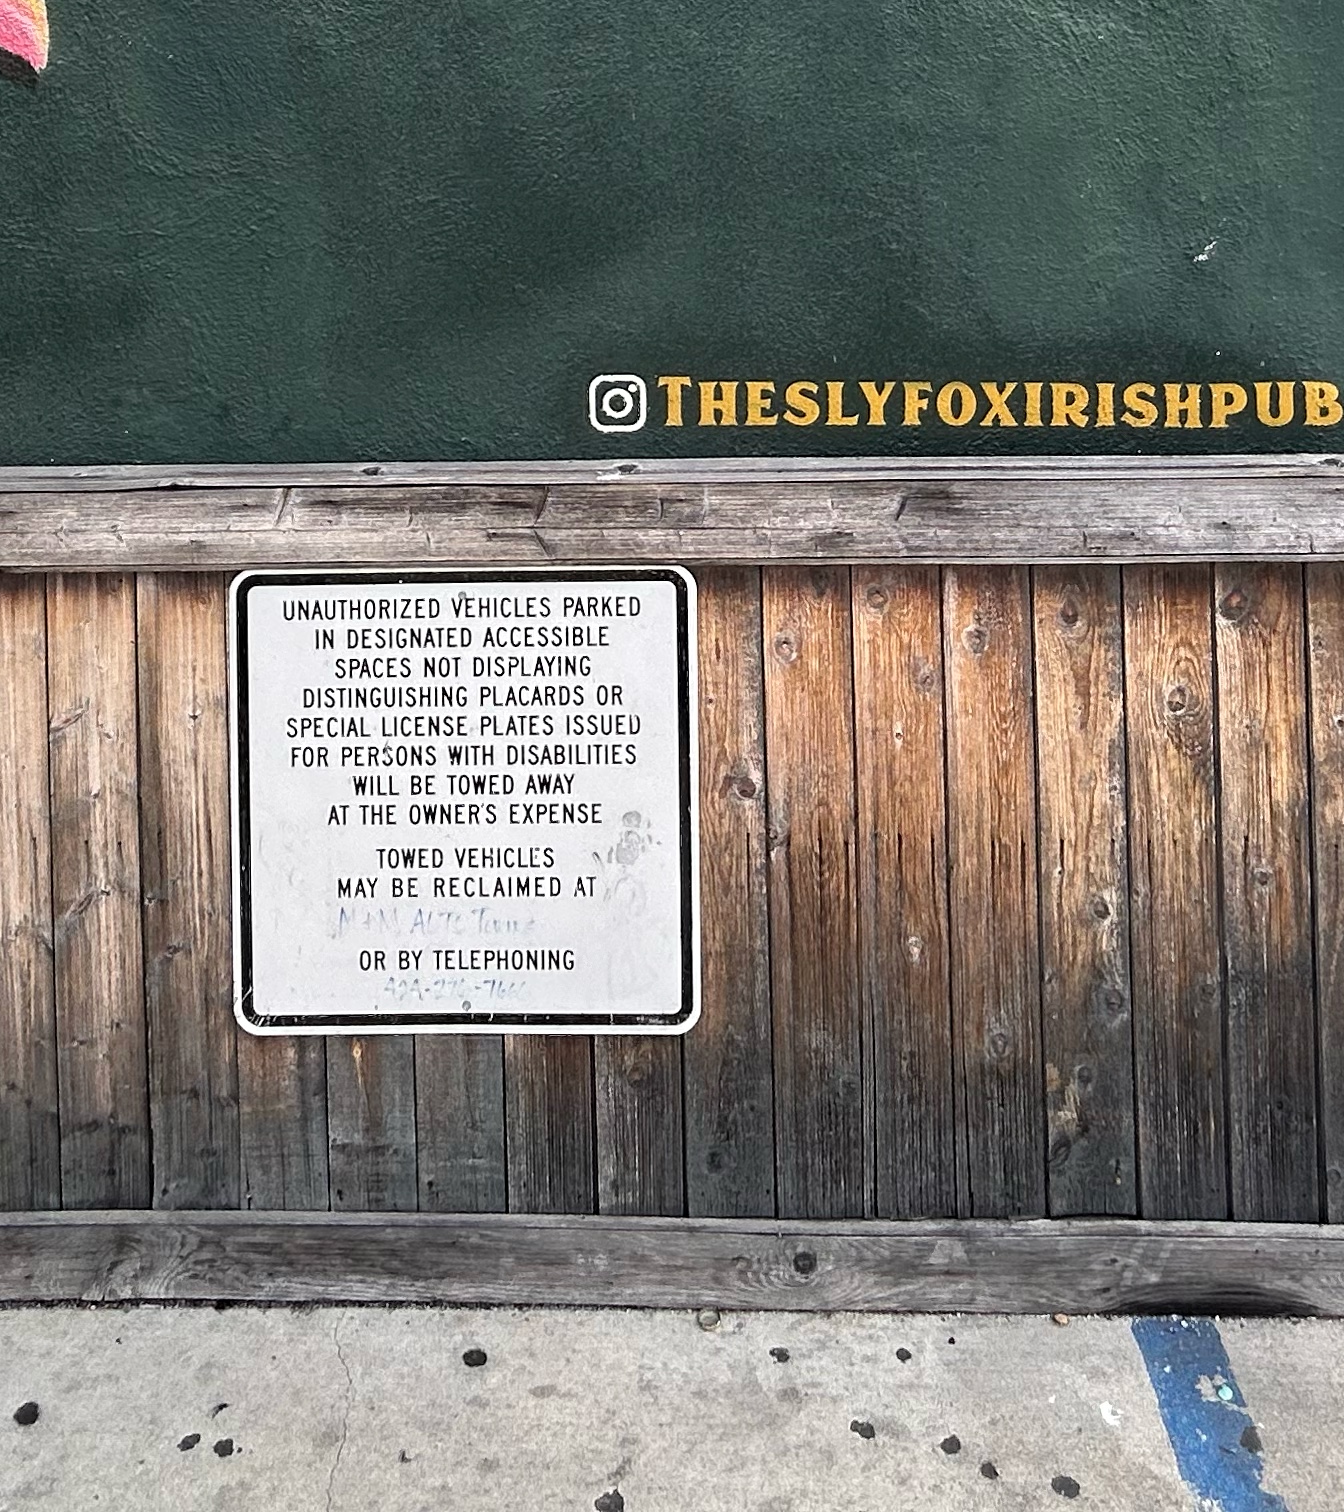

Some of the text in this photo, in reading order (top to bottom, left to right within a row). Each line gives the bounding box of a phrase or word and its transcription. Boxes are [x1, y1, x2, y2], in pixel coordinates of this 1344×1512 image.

[658, 374, 1344, 430] THESLYFOXIRISHPUB
[282, 596, 641, 621] UNAUTHORIZED VEHICLES PARKED
[315, 625, 610, 650] IN DESIGNATED ACCESSIBLE
[334, 655, 591, 679] SPACES NOT DISPLAYING
[303, 684, 623, 709] DISTINGUISHING PLACARDS OR
[286, 714, 641, 738] SPECIAL LICENSE PLATES ISSUED
[291, 744, 637, 768] FOR PERSONS WITH DISABILITIES
[352, 773, 575, 796] WILL BE TOWED AWAY
[327, 803, 603, 826] AT THE OWNER'S EXPENSE
[375, 847, 555, 869] TOWED VEHICLES
[337, 876, 597, 899] MAY BE RECLAIMED AT
[359, 949, 575, 972] OR BY TELEPHONING
